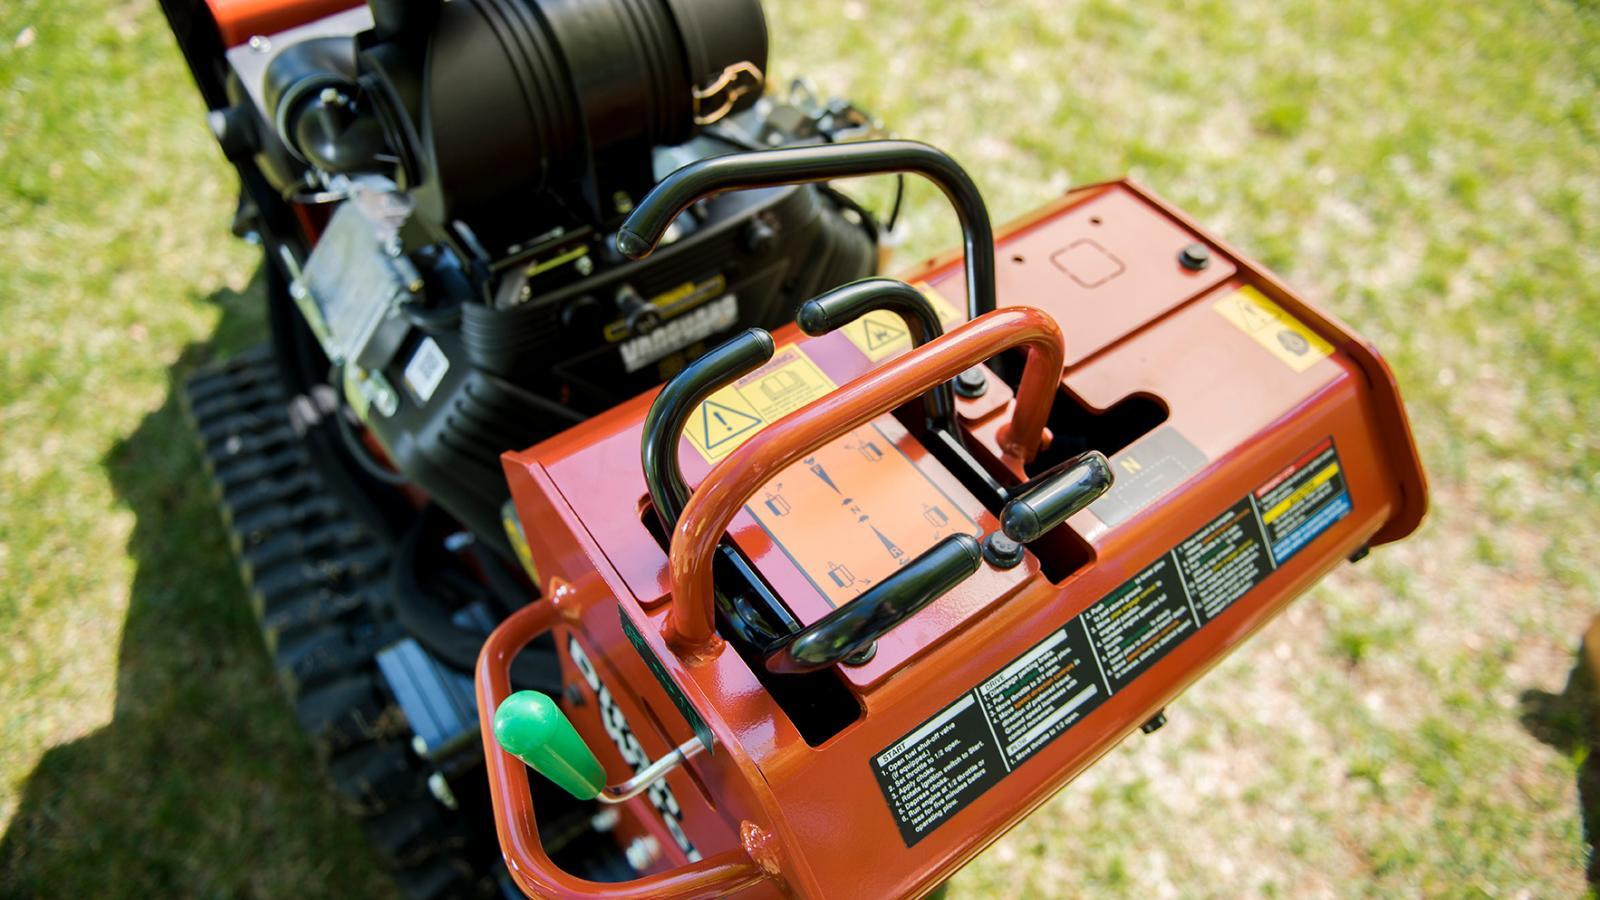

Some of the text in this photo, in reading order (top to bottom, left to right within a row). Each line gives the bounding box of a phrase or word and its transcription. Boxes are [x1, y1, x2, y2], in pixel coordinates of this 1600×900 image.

[1120, 456, 1142, 474] N
[985, 675, 1003, 690] DRIVE
[882, 742, 905, 761] START
[888, 757, 904, 771] Open
[904, 748, 917, 760] fuel
[917, 732, 939, 751] shut-off
[939, 722, 955, 735] valve
[899, 749, 930, 774] equipped.)
[894, 776, 905, 787] Set
[905, 762, 927, 779] throttle
[934, 749, 944, 758] 1/2
[944, 739, 960, 752] open.
[901, 786, 921, 802] Rotate
[920, 770, 943, 788] ignition
[943, 757, 961, 772] switch
[968, 741, 984, 754] Start.
[898, 780, 915, 794] Apply
[916, 767, 935, 782] choke.
[904, 790, 929, 809] Depress
[929, 777, 948, 792] choke.
[908, 806, 921, 817] Run
[921, 791, 940, 808] engine
[941, 785, 947, 793] at
[947, 778, 957, 788] 1/2
[956, 764, 977, 781] throttle
[911, 768, 985, 824] less for five minutes before
[915, 799, 957, 832] operating plow.
